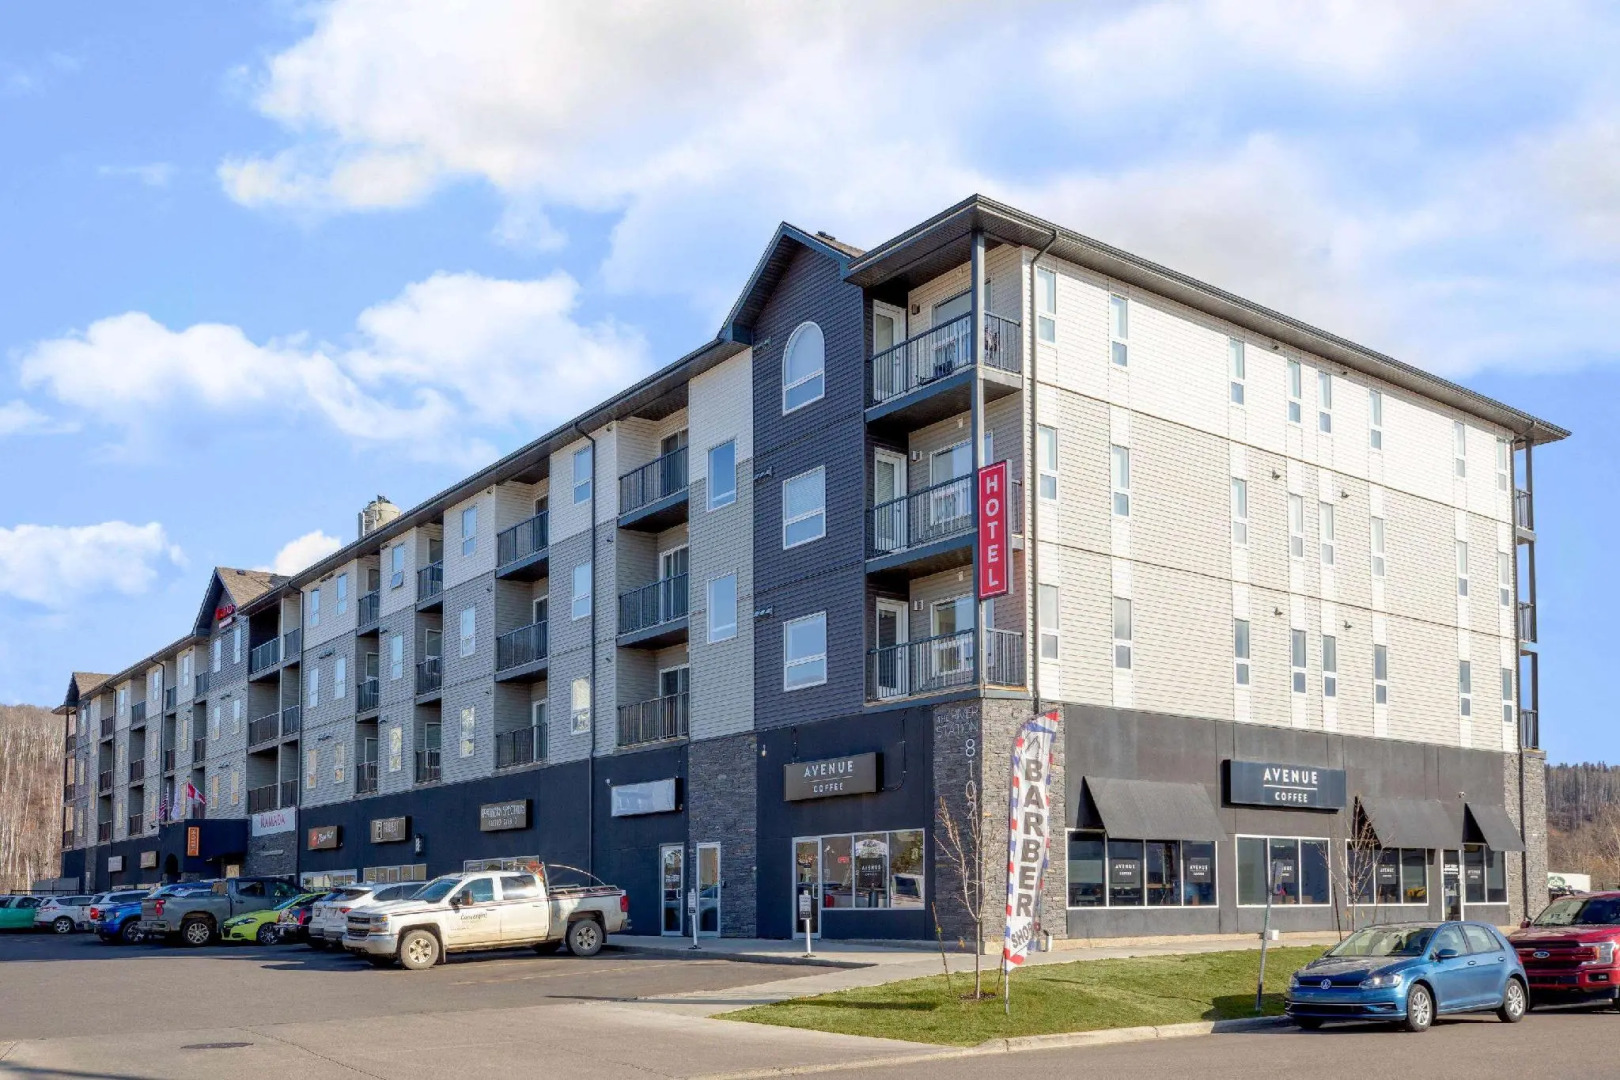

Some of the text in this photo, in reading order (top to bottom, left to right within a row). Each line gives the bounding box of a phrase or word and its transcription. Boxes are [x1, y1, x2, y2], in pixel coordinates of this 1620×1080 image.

[985, 474, 1000, 587] HOTEL
[803, 760, 854, 778] AVENUE
[1263, 767, 1318, 785] AVENUE
[813, 782, 844, 793] COFFEE
[1275, 791, 1308, 803] COFFEE
[260, 814, 286, 828] RAMADA
[1016, 757, 1045, 918] BARBER
